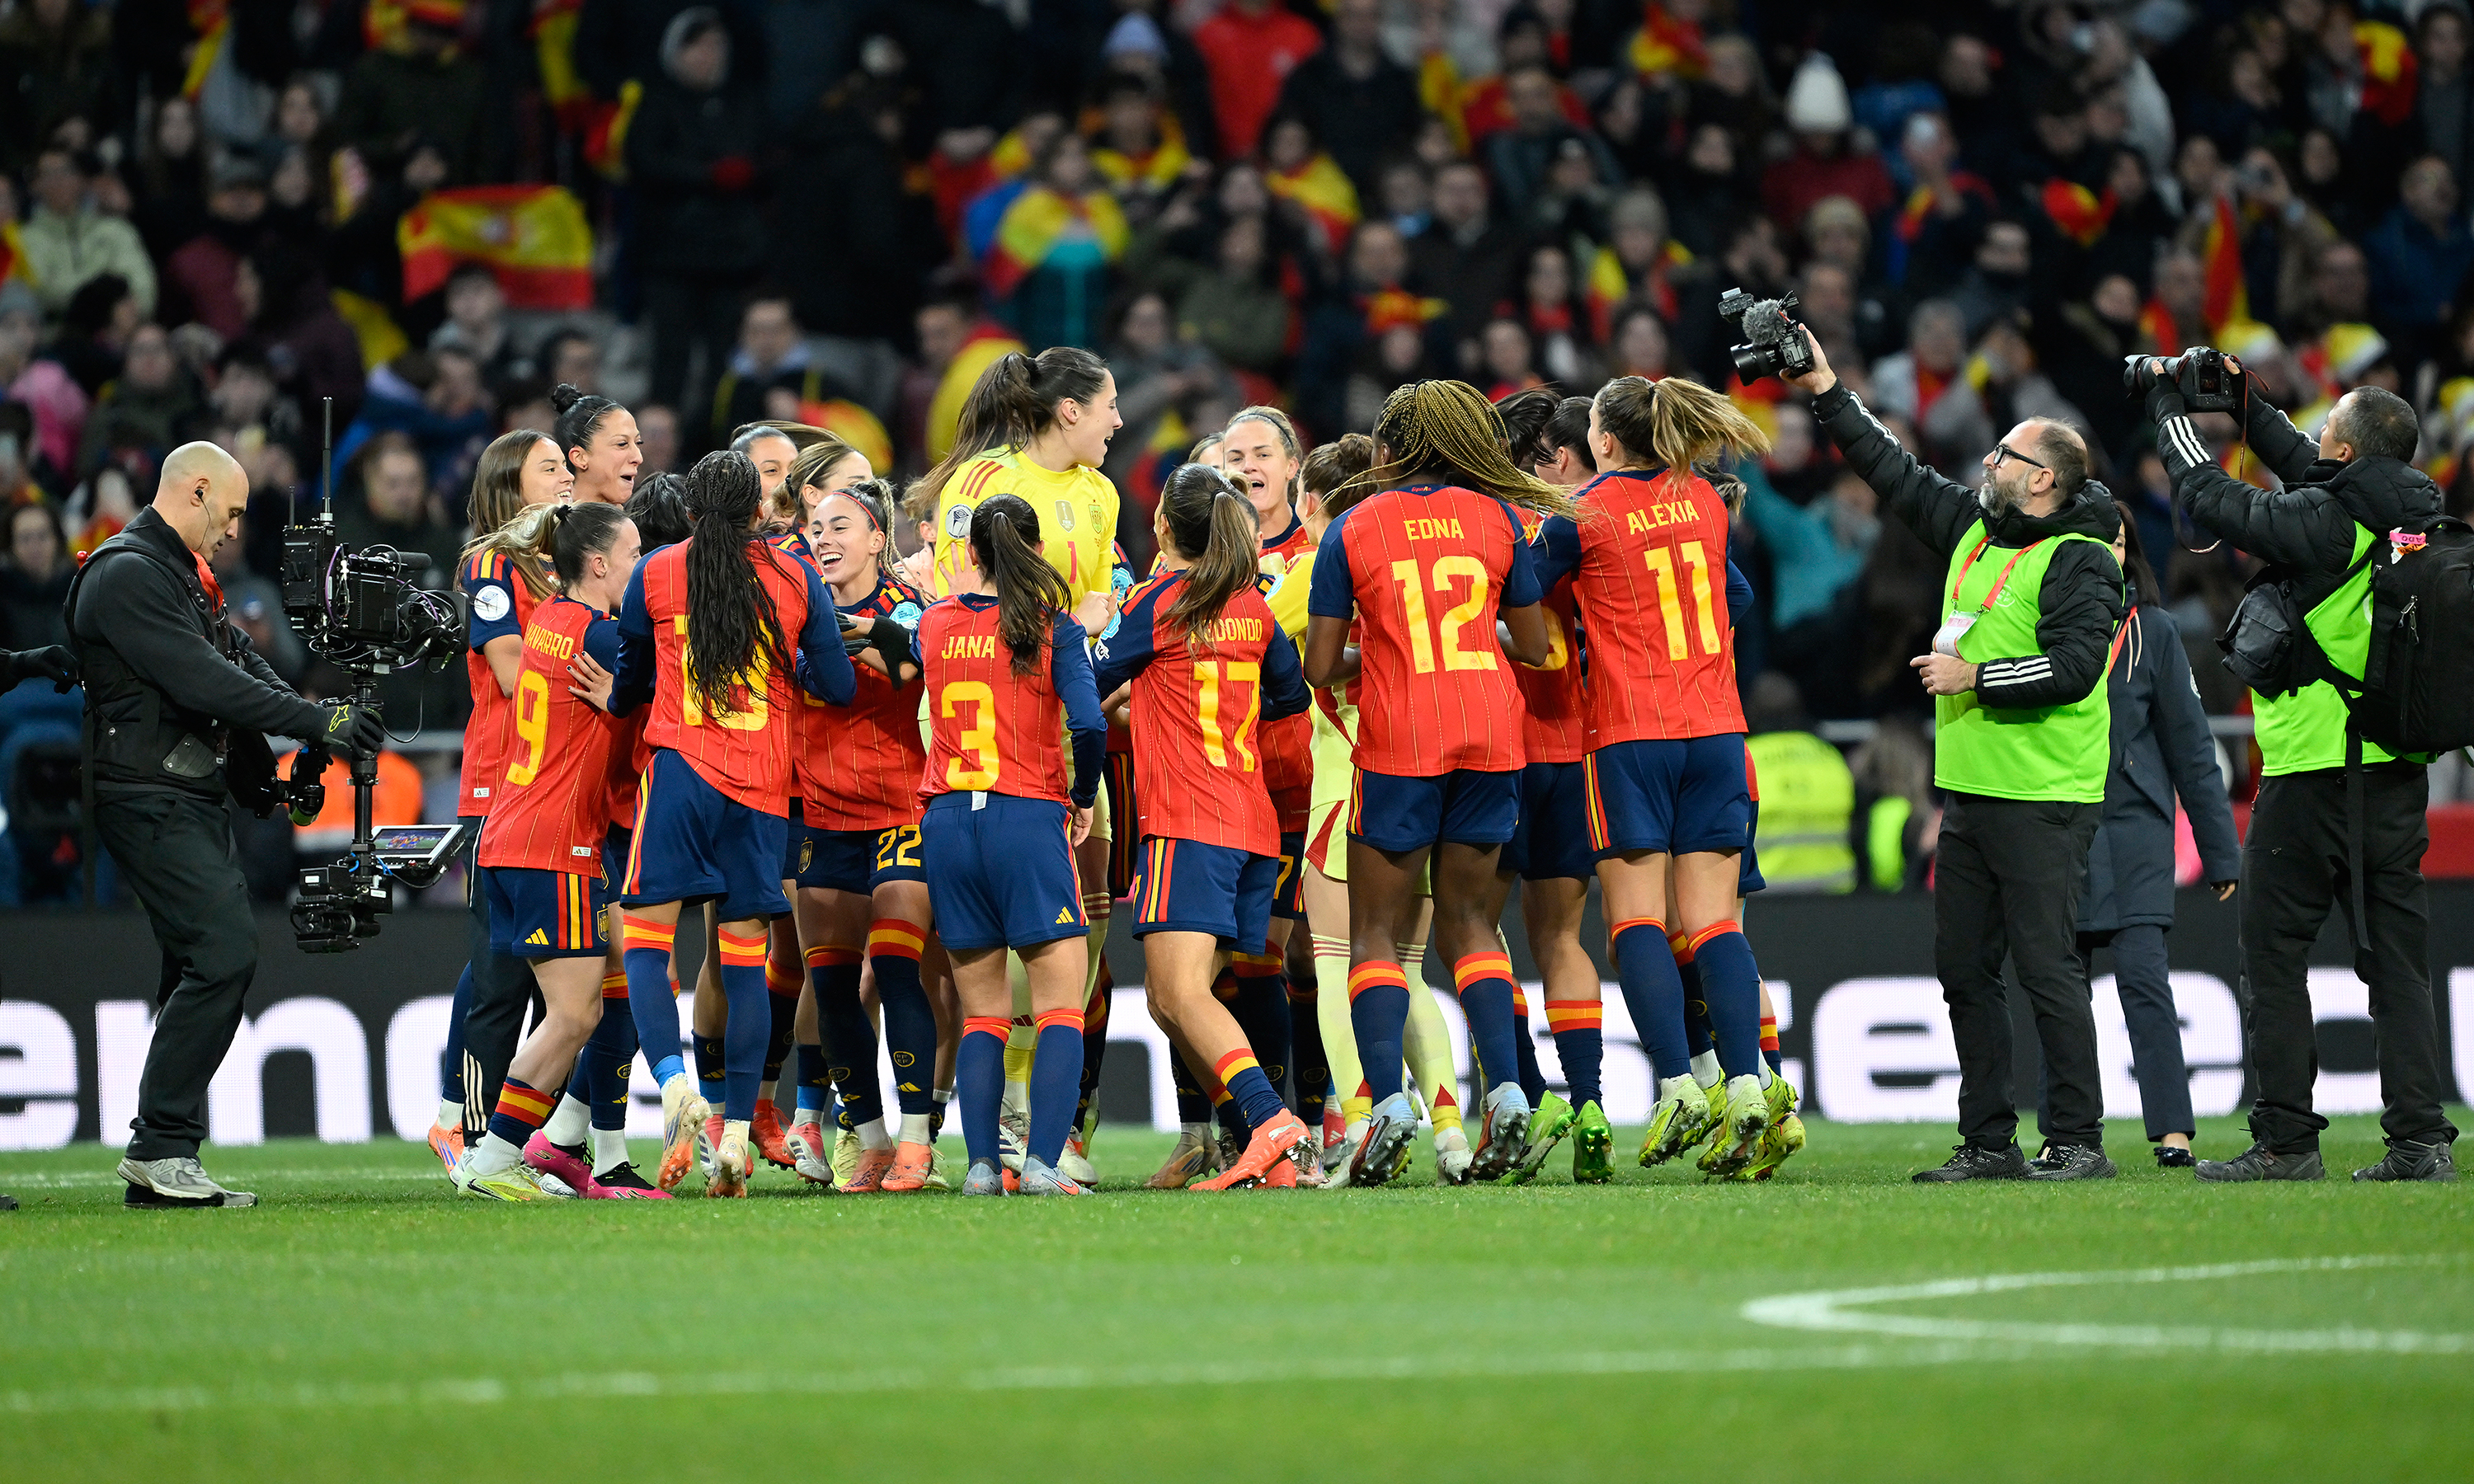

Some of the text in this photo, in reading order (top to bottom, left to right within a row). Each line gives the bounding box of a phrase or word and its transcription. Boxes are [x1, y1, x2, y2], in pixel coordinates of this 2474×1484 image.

[1403, 518, 1465, 542] EDNA
[1626, 499, 1701, 536] ALEXIA
[2401, 535, 2425, 543] ADO
[1067, 541, 1077, 584] 1
[1391, 555, 1499, 674] 12
[1644, 541, 1721, 661] 11
[524, 619, 574, 660] NAVARRO
[941, 636, 995, 660] JANA
[505, 670, 550, 787] 9
[941, 680, 1000, 791] 3
[1193, 661, 1261, 773] 17
[877, 824, 922, 871] 22
